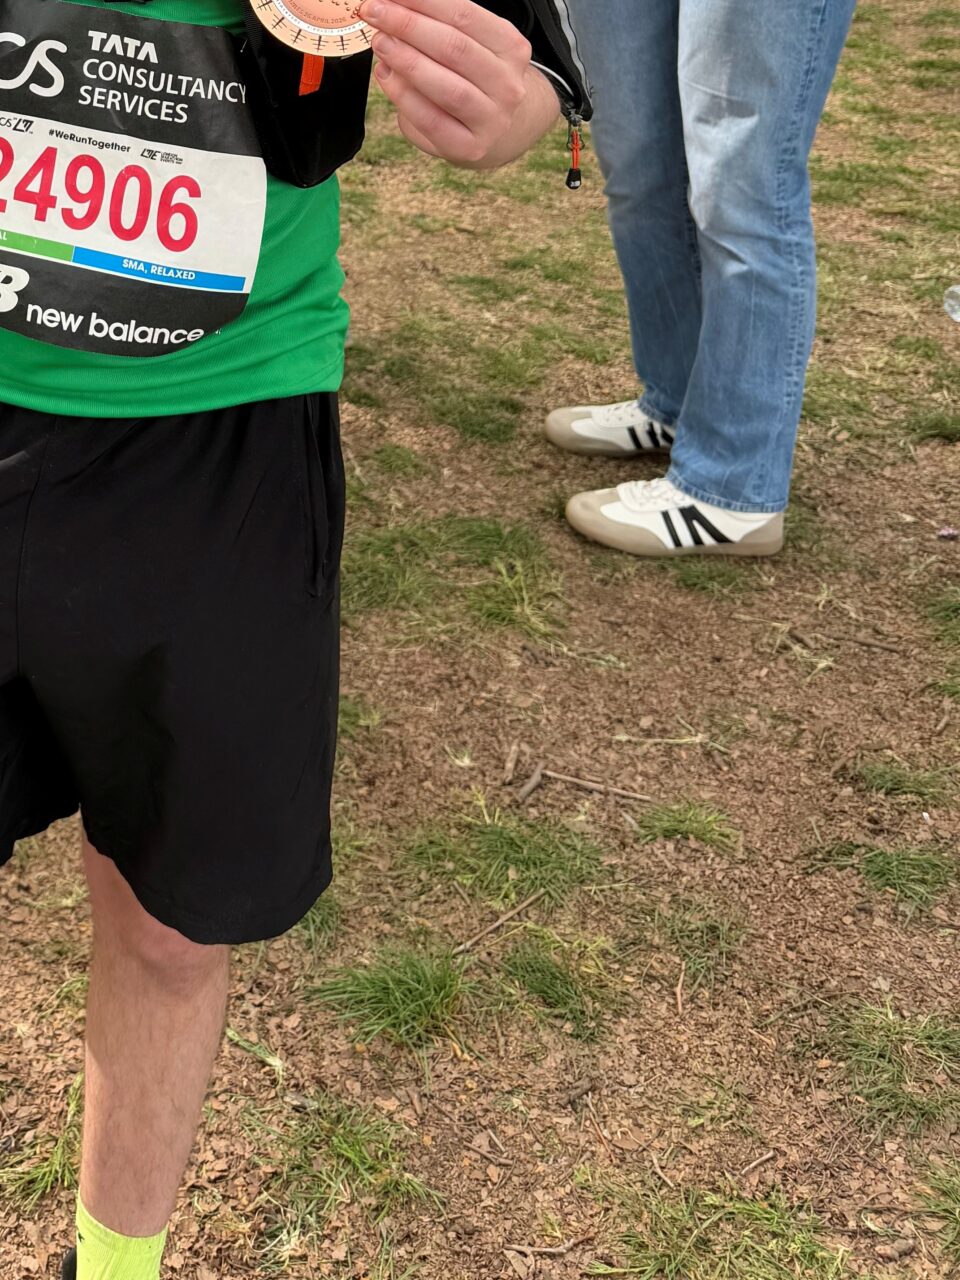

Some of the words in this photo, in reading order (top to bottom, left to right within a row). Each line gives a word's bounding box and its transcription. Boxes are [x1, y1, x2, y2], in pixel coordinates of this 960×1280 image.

[88, 30, 159, 63] TATA
[82, 58, 246, 104] CONSULTANCY
[78, 86, 189, 123] SERVICES
[48, 128, 131, 153] #WeRunTogether
[122, 258, 149, 273] SMA,
[150, 263, 196, 280] RELAXED
[26, 302, 84, 332] new
[88, 312, 205, 344] balance
